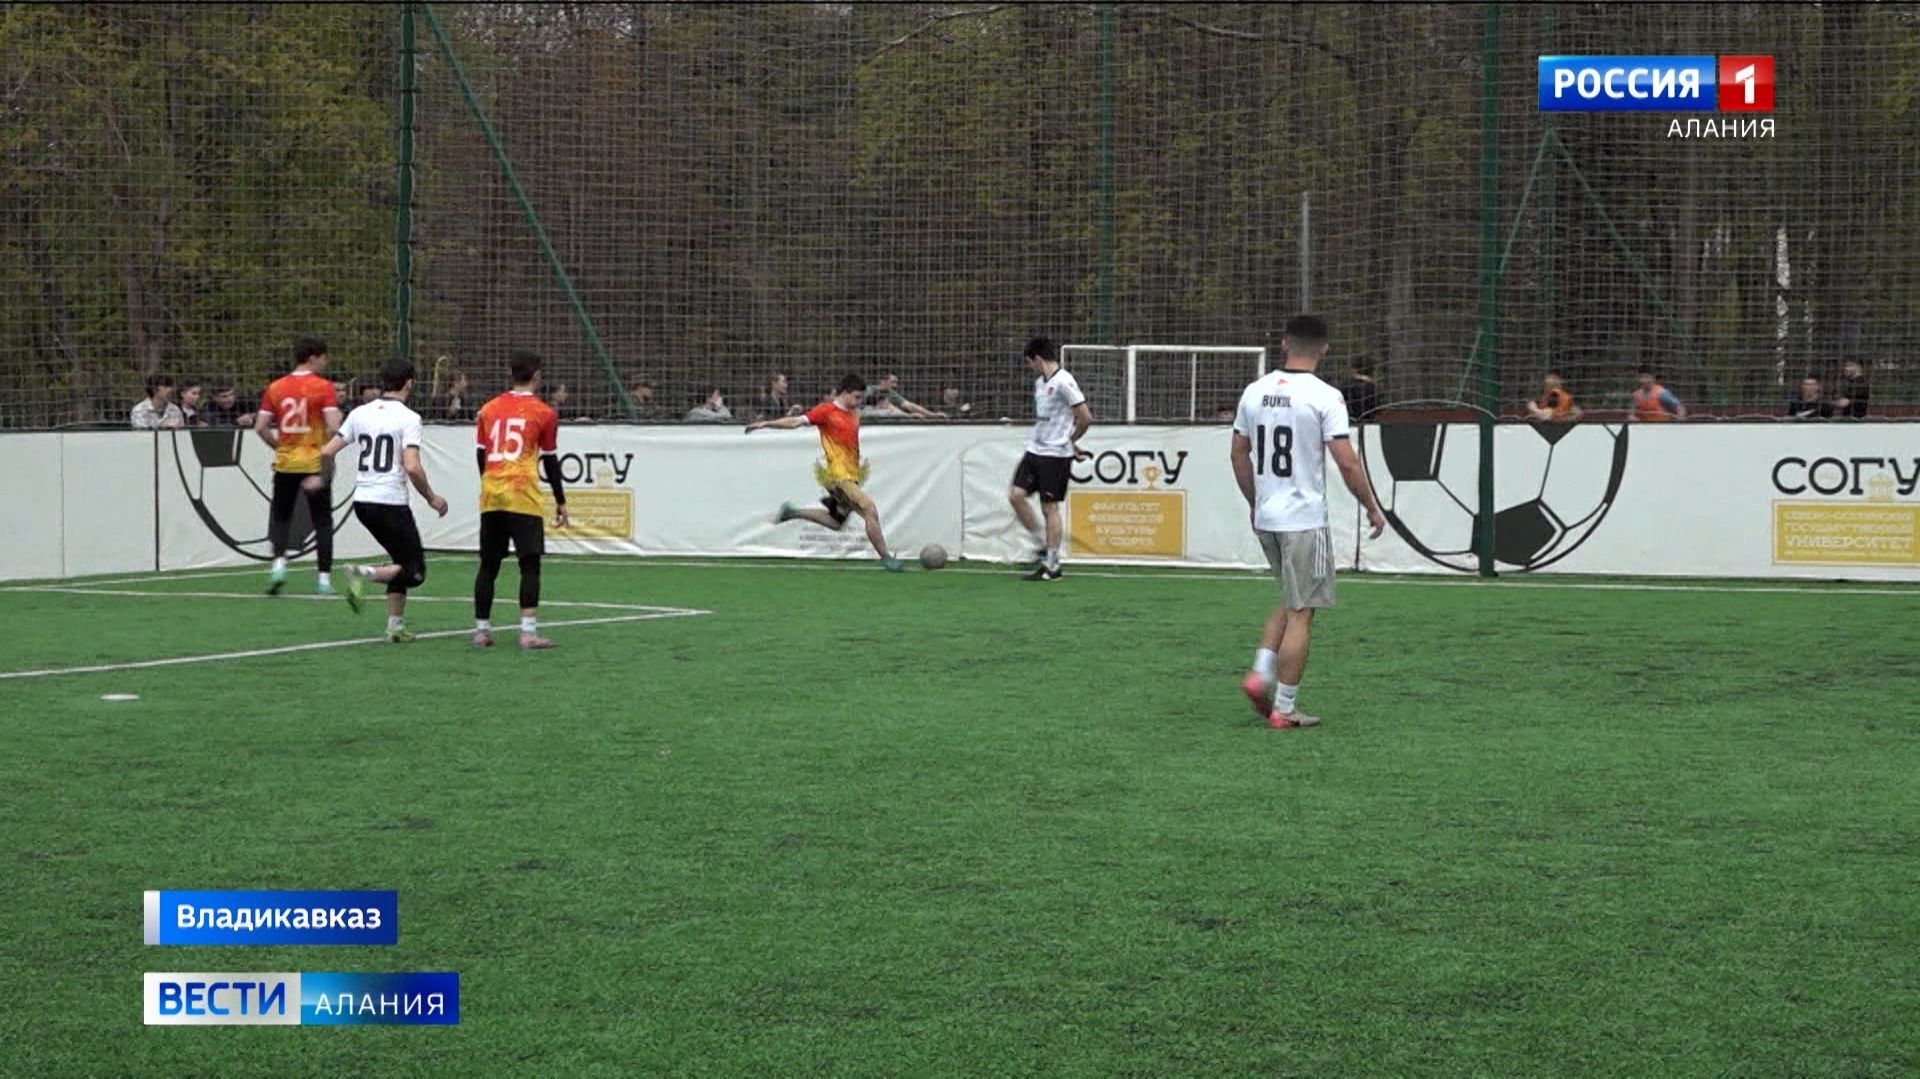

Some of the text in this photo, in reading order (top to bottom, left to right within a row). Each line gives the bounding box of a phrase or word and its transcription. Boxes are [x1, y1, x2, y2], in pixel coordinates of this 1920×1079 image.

[281, 397, 311, 434] 21
[358, 433, 394, 473] 20
[487, 418, 526, 462] 15
[1257, 424, 1293, 478] 18
[1771, 456, 1920, 495] СОГУ
